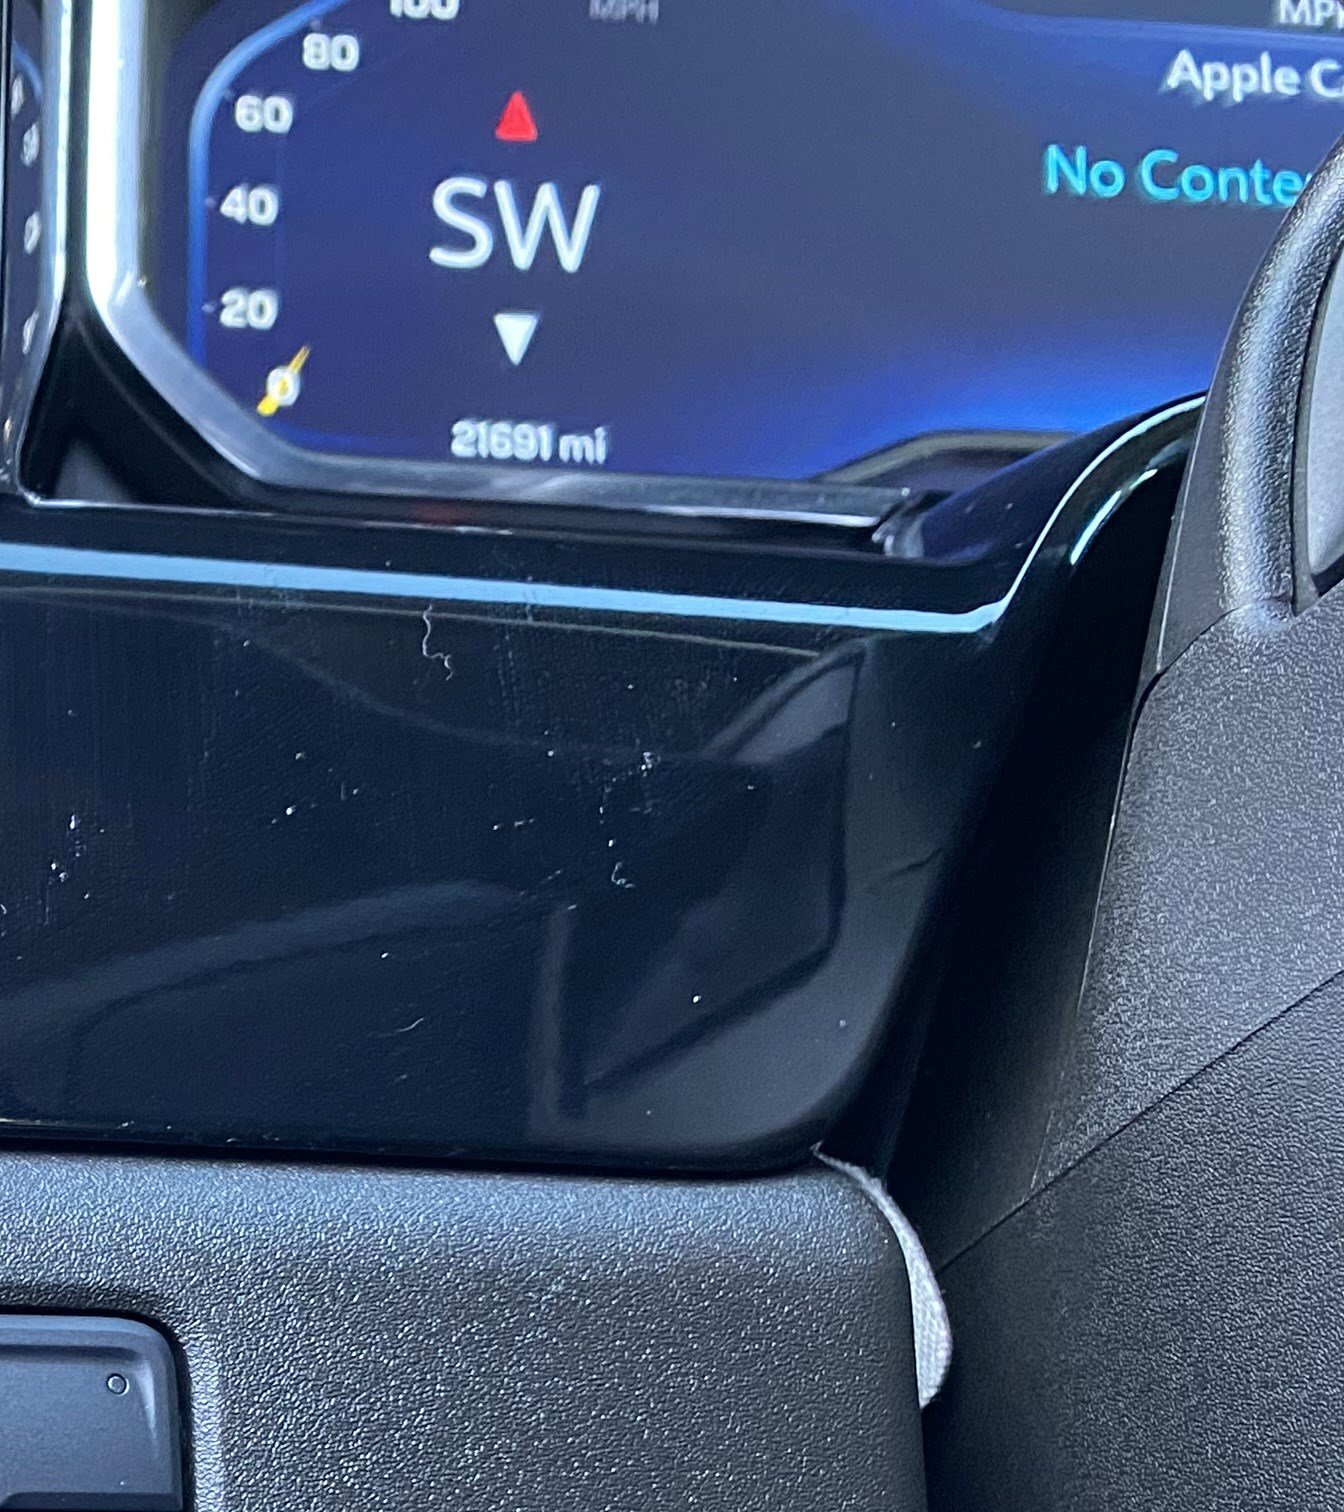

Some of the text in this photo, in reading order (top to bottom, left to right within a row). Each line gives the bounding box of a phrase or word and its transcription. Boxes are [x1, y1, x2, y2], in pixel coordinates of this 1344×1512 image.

[302, 33, 360, 71] 80
[1166, 48, 1301, 102] Apple
[234, 95, 294, 134] 60
[1045, 144, 1312, 207] No Conte
[220, 185, 279, 226] 40
[429, 176, 601, 273] SW
[219, 288, 278, 330] 20
[451, 420, 607, 464] 21691 mi
